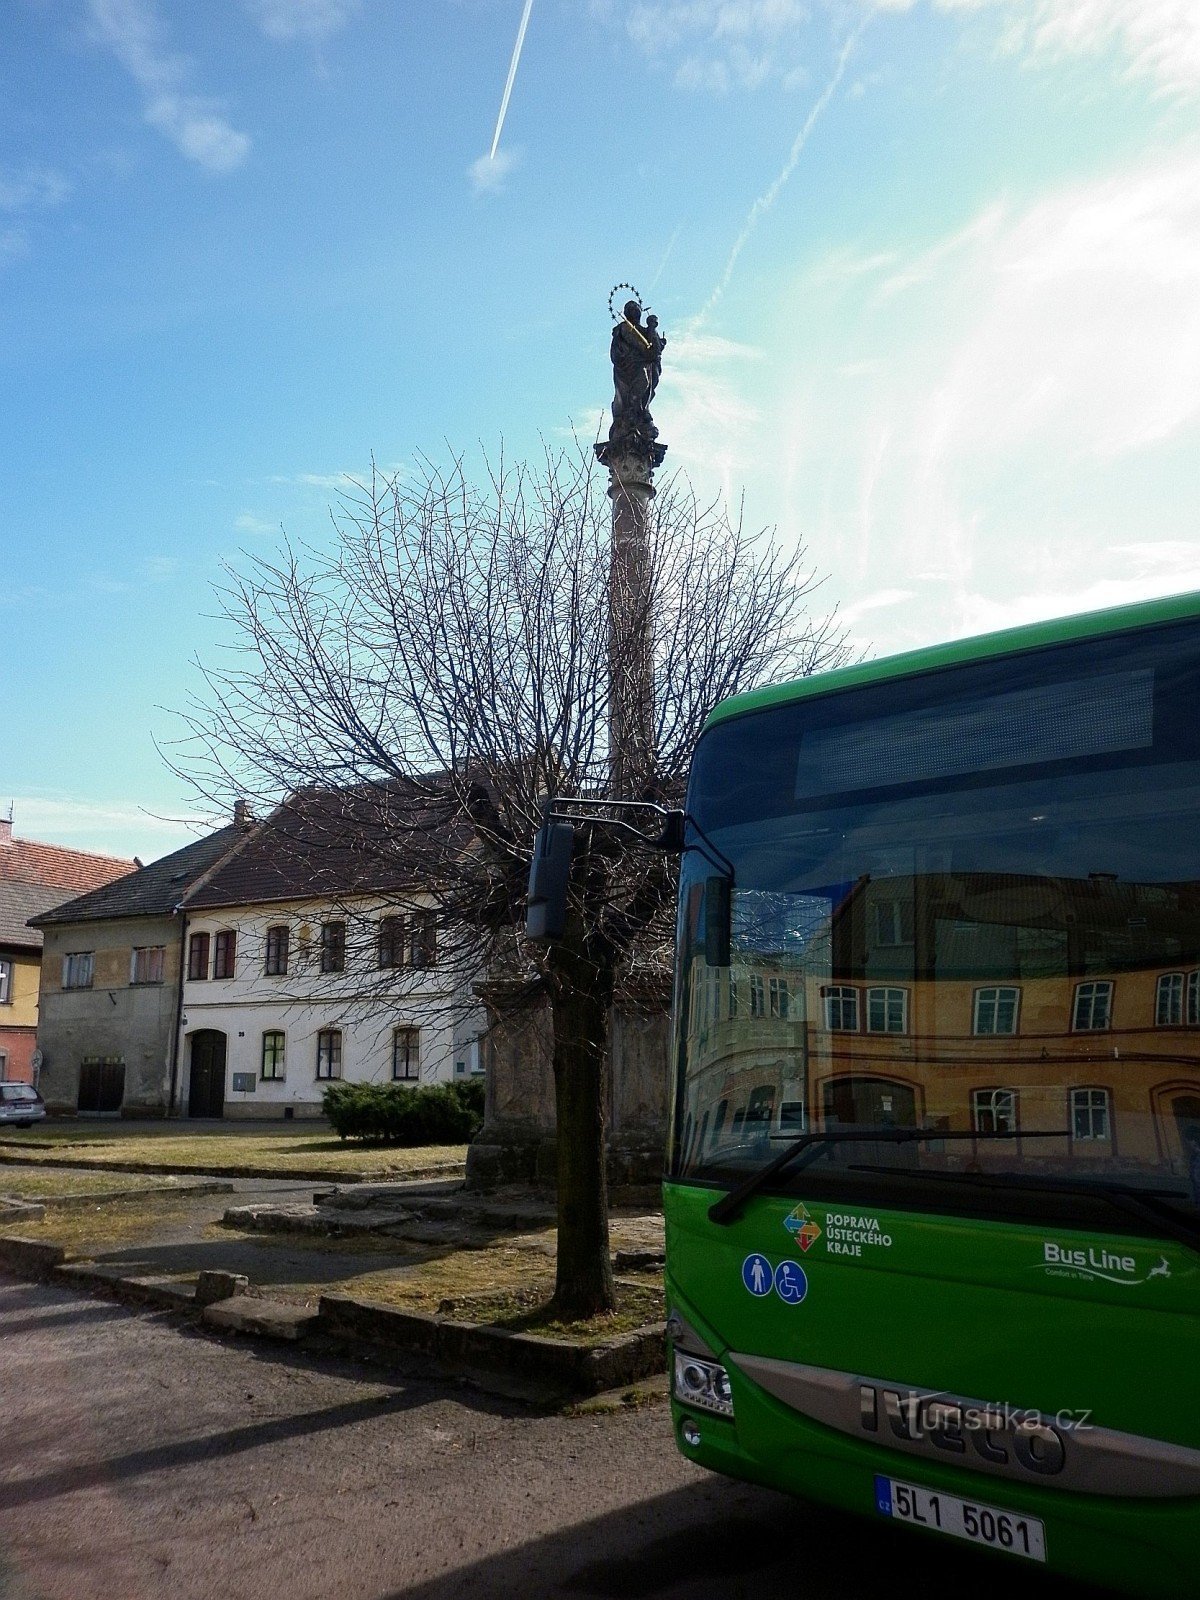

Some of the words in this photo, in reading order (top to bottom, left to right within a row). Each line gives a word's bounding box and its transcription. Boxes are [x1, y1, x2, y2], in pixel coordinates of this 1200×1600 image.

[826, 1213, 880, 1231] DOPRAVA
[826, 1225, 892, 1247] ÚSTECKÉHO
[826, 1241, 862, 1257] KRAJE
[878, 1499, 891, 1512] CZ
[895, 1485, 942, 1527] 5L1
[962, 1504, 1030, 1554] 5061
